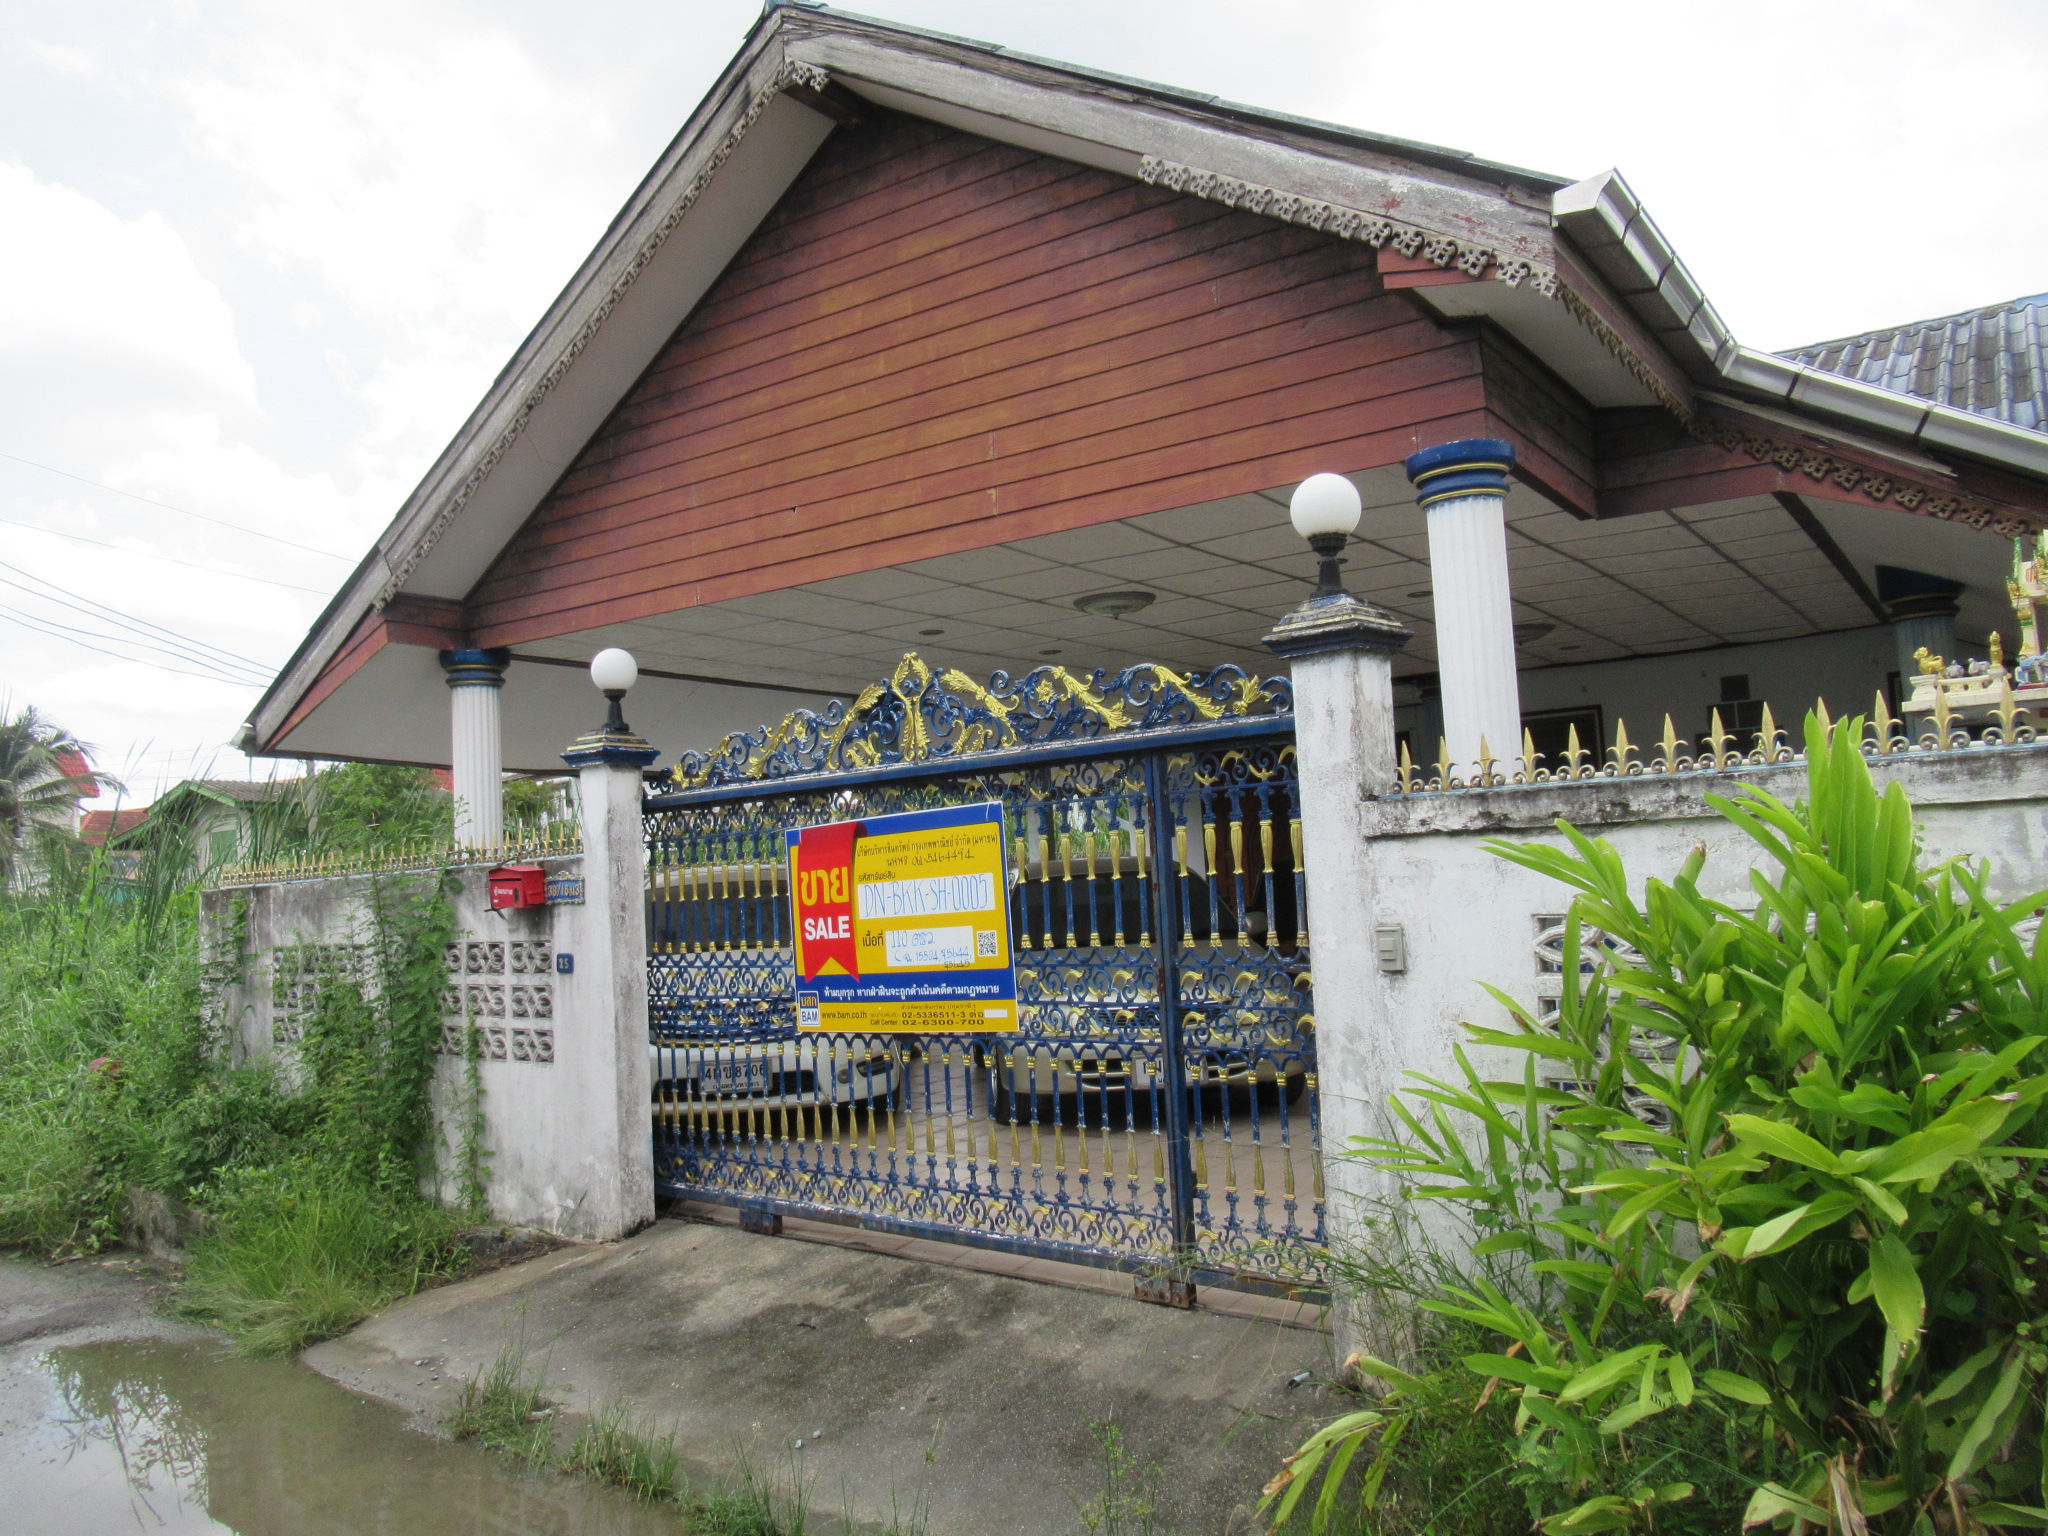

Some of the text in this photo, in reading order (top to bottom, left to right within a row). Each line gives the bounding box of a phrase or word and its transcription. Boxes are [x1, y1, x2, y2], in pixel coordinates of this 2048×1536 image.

[800, 866, 850, 906] ขาย
[864, 873, 988, 918] DN-BKK-SH-0005
[804, 915, 851, 941] SALE
[862, 930, 884, 947] เนื้อที่
[824, 986, 855, 1001] ห้ามบุกรุก
[801, 1011, 818, 1022] BAM
[822, 1011, 867, 1019] www.bam.co.th
[902, 1011, 966, 1019] 02-5336511-3
